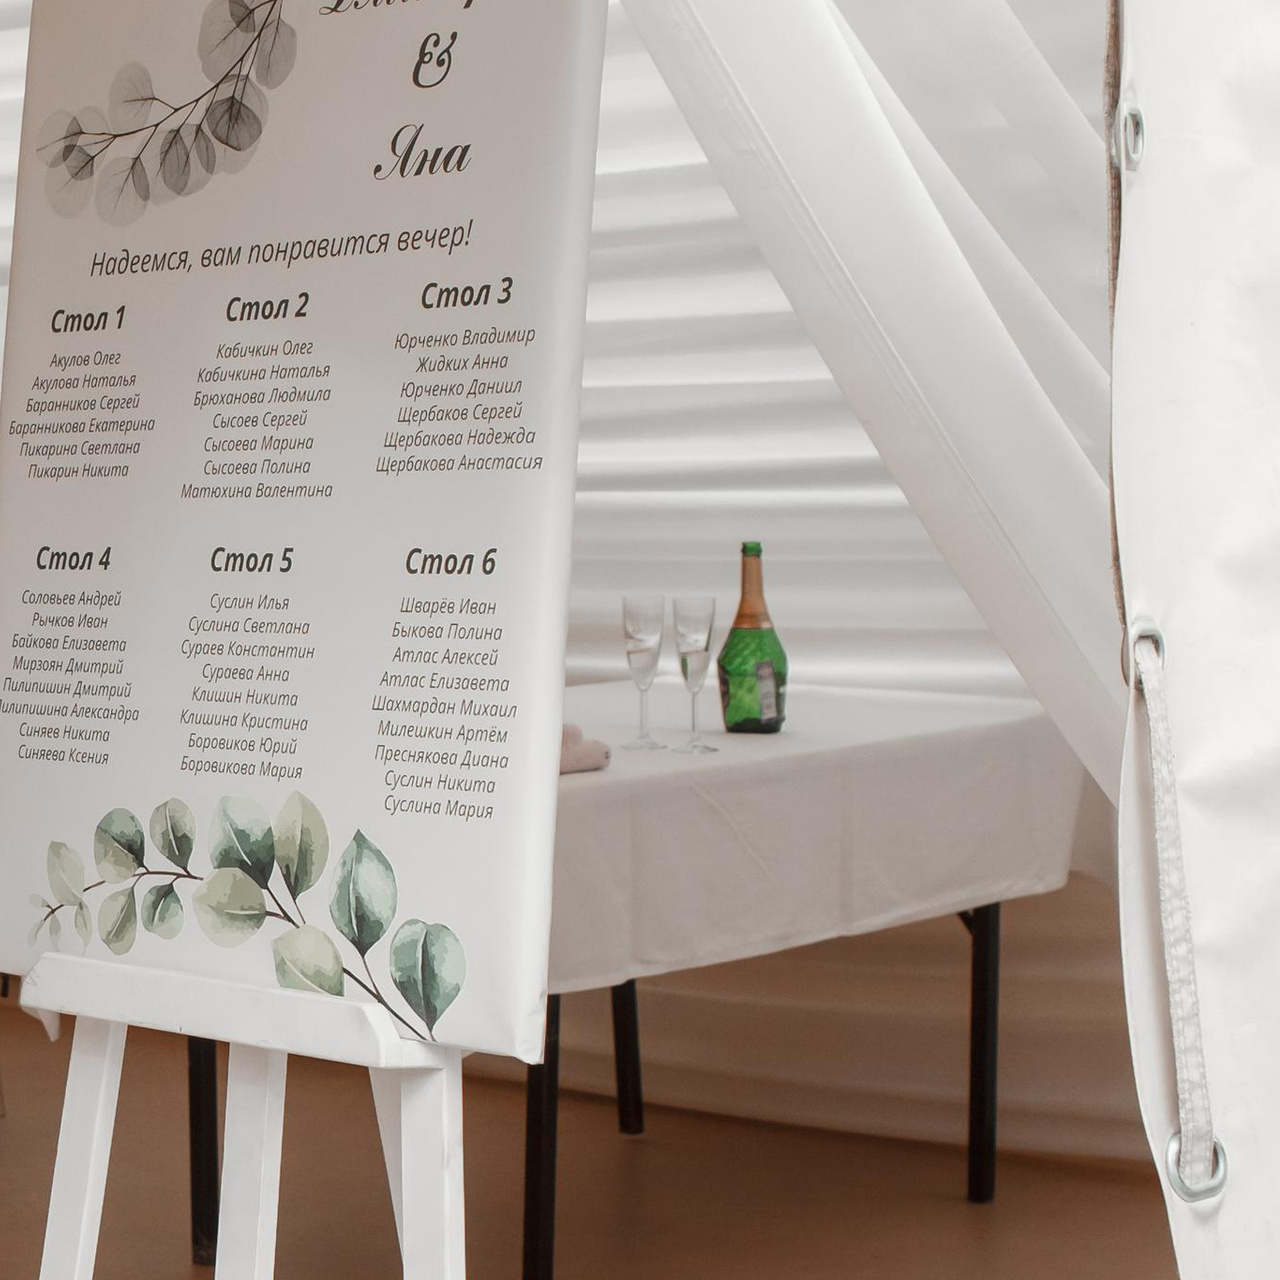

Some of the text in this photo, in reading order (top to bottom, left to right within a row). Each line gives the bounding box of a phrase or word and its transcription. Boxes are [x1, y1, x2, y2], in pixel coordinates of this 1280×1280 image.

[412, 31, 458, 88] &
[373, 123, 472, 180] Яна
[90, 219, 474, 277] Надеемся, вам понравится вечер!
[421, 276, 513, 309] Стол 3
[226, 292, 310, 322] Стол 2
[51, 305, 126, 333] Стол 1
[216, 340, 313, 359] Кабичкин Олег
[394, 327, 536, 353] Юрченко Владимир
[50, 351, 121, 371] Акулов Олег
[416, 354, 509, 373] Жидких Анна
[32, 374, 136, 394] Акулова Наталья
[197, 364, 330, 383] Кабичкина Наталья
[193, 386, 331, 410] Брюханова Людмила
[400, 379, 522, 402] Юрченко Даниил
[26, 393, 140, 416] Баранников Сергей
[397, 401, 523, 426] Щербаков Сергей
[9, 418, 155, 438] Баранникова Екатерина
[212, 410, 308, 430] Сысоев Сергей
[204, 436, 314, 454] Сысоева Марина
[384, 427, 536, 451] Щербакова Надежда
[20, 441, 141, 460] Пикарина Светлана
[28, 463, 129, 482] Пикарин Никита
[204, 459, 311, 475] Сысоева Полина
[376, 455, 543, 476] Щербакова Анастасия
[181, 482, 333, 499] Матюхина Валентина
[36, 546, 112, 571] Стол 4
[210, 546, 294, 573] Стол 5
[405, 547, 497, 576] Стол 6
[22, 589, 122, 610] Соловьев Андрей
[210, 594, 290, 613] Суслин Илья
[400, 597, 497, 618] Шварёв Иван
[32, 612, 108, 629] Рычков Иван
[188, 616, 310, 635] Суслина Светлана
[392, 621, 502, 641] Быкова Полина
[12, 634, 127, 652] Байкова Елизавета
[181, 639, 315, 659] Сураев Константин
[13, 656, 124, 678] Мирзоян Дмитрий
[392, 647, 499, 666] Атлас Алексей
[202, 663, 290, 683] Сураева Анна
[379, 671, 509, 692] Атлас Елизавета
[3, 677, 132, 701] Пилипишин Дмитрий
[192, 686, 298, 706] Клишин Никита
[71, 703, 139, 724] Александра
[372, 695, 518, 718] Шахмардан Михаил
[180, 709, 308, 732] Клишина Кристина
[19, 722, 110, 742] Синяев Никита
[377, 720, 508, 745] Милешкин Артём
[18, 744, 109, 765] Синяева Ксения
[188, 733, 297, 757] Боровиков Юрий
[374, 744, 509, 769] Преснякова Диана
[181, 756, 303, 782] Боровикова Мария
[384, 770, 496, 794] Суслин Никита
[384, 795, 494, 821] Суслина Мария
